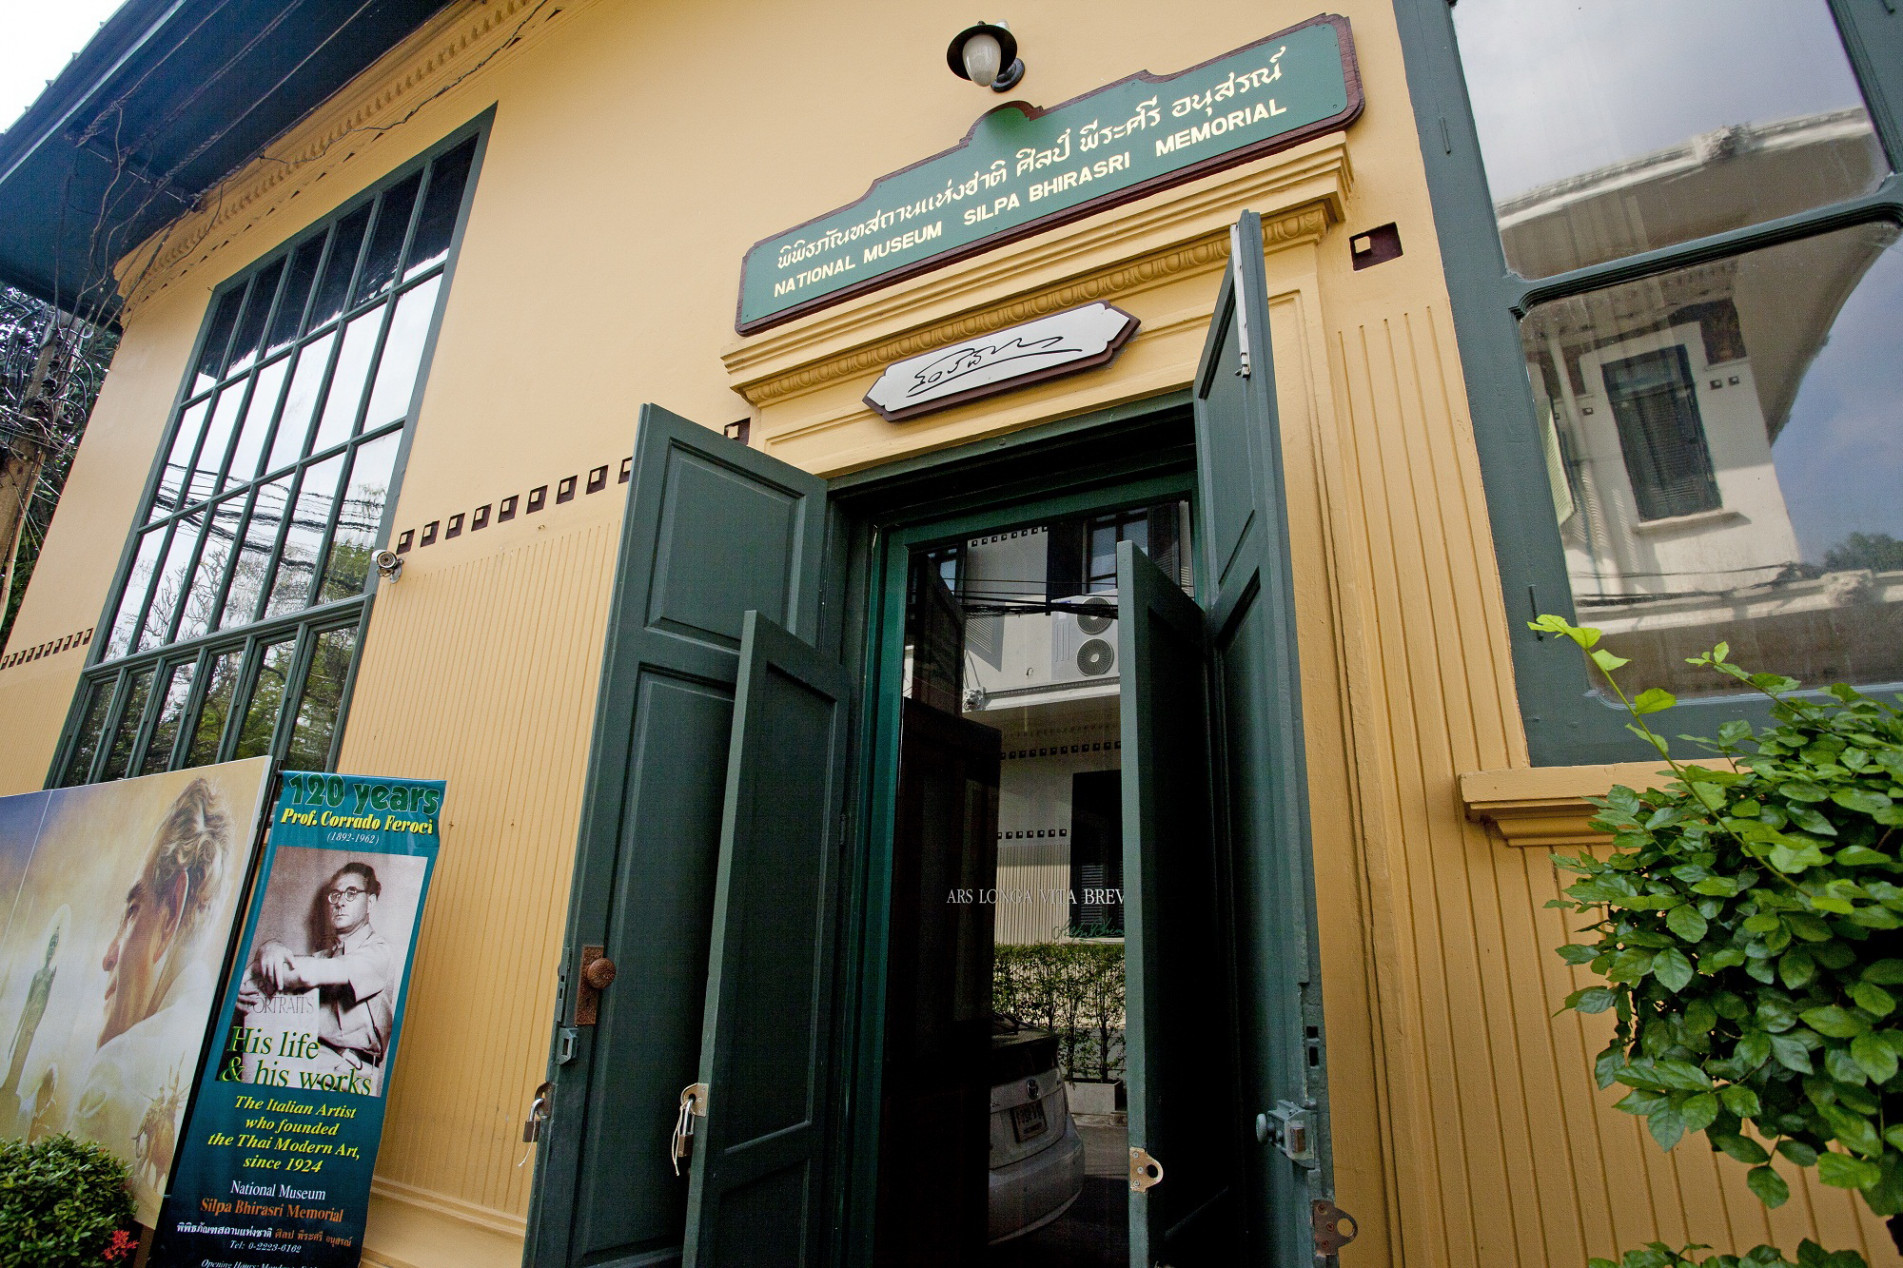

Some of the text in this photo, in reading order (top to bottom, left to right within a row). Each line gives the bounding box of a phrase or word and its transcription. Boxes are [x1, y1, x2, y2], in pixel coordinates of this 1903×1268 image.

[1079, 94, 1161, 152] พีระศรี
[1171, 46, 1287, 117] อนุสรณ์
[774, 99, 1287, 298] NATIONAL MUSEUM SILPA BHIRASRI MEMORIAL
[289, 773, 440, 815] 120 years
[280, 807, 433, 835] Prof. Corrado Feroci
[326, 831, 380, 846] (1892-1962)
[946, 888, 973, 905] ARS
[979, 888, 1034, 905] LONGA
[1039, 888, 1077, 905] VITA
[252, 995, 314, 1014] ORTRAITS
[227, 1025, 321, 1060] His life
[219, 1056, 372, 1096] & his works
[234, 1095, 357, 1119] The Italian Artist
[245, 1116, 341, 1136] who founded
[207, 1132, 361, 1161] the Thai Modern Art,
[243, 1155, 325, 1173] since 1924
[229, 1179, 327, 1200] National Museum
[200, 1197, 344, 1223] Silpa Bhirasri Memorial
